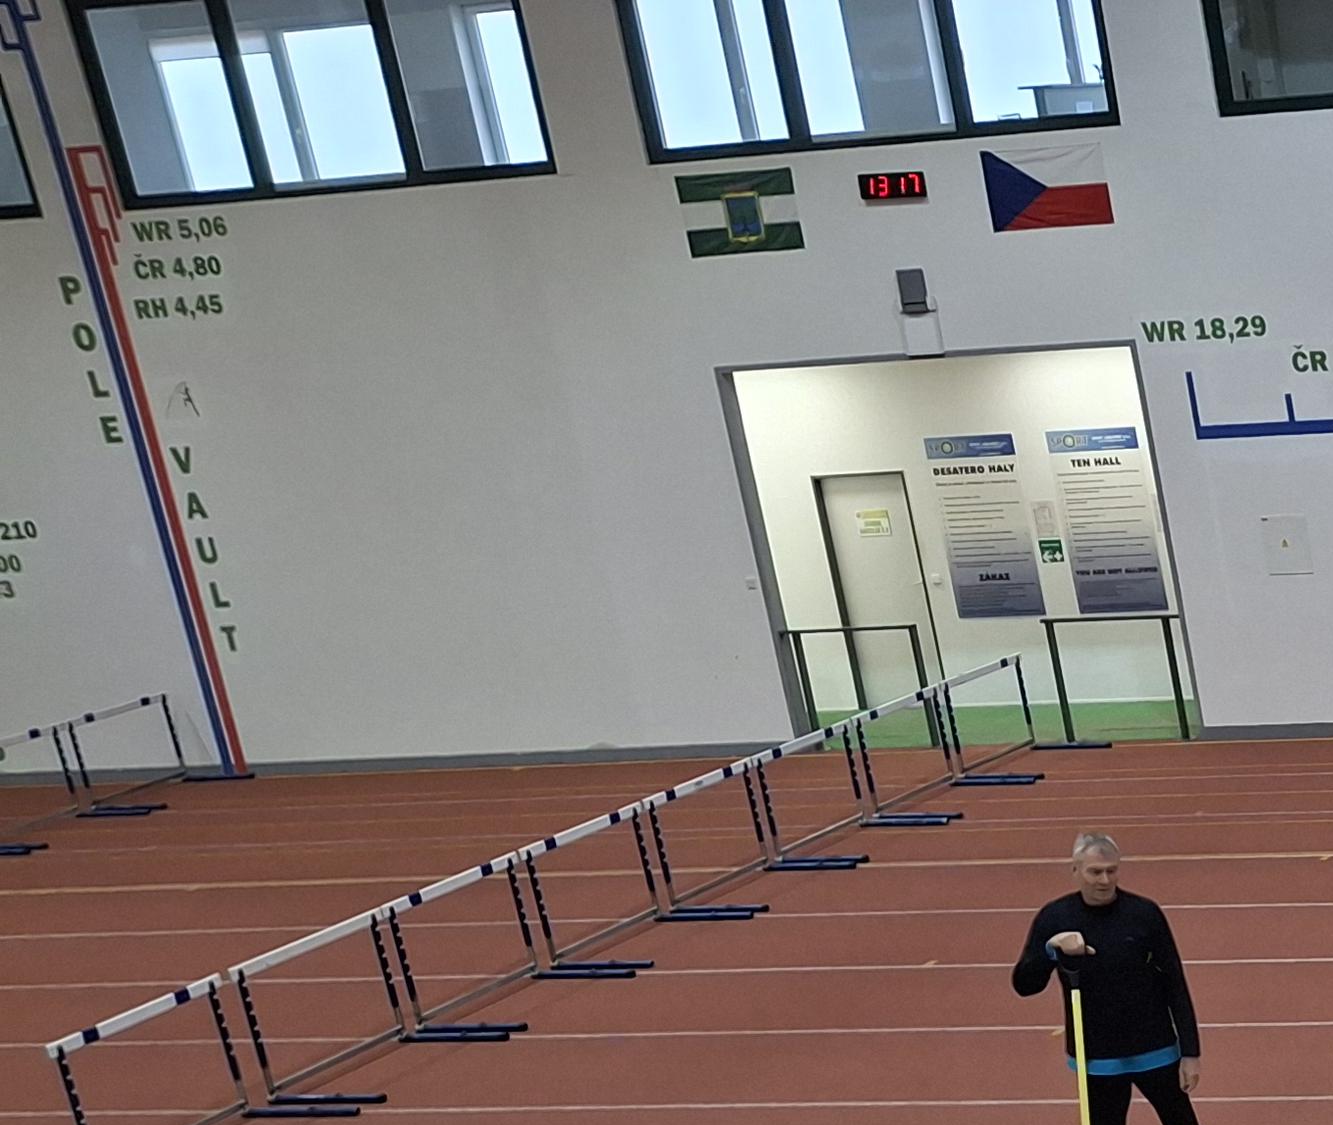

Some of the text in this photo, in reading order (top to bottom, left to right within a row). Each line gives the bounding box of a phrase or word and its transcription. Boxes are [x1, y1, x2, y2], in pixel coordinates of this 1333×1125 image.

[131, 215, 228, 245] WR 5,06
[133, 253, 222, 284] ČR 4,80
[133, 292, 224, 323] RH 4,45
[1140, 314, 1267, 346] WR 18,29
[1291, 344, 1329, 373] ČR
[987, 463, 1016, 475] HALY
[1070, 456, 1122, 469] TEN HALL
